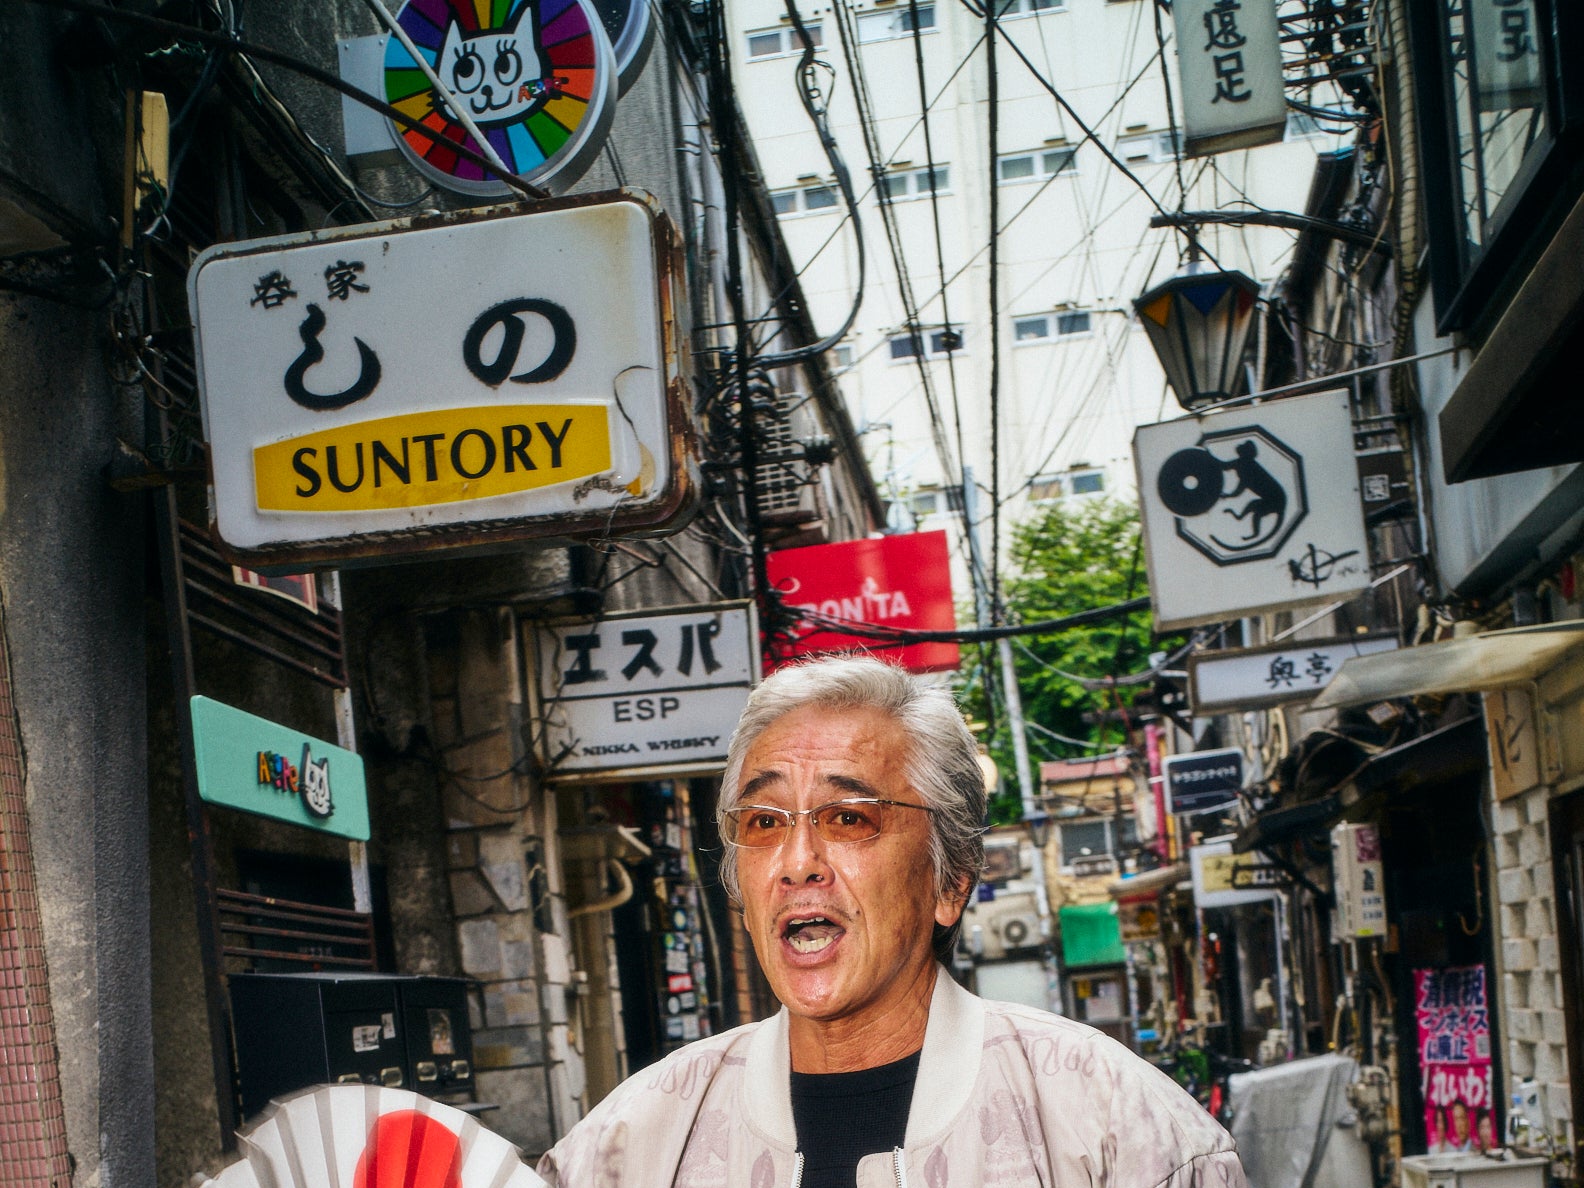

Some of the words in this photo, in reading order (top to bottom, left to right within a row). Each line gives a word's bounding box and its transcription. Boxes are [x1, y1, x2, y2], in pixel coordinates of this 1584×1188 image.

[1203, 0, 1252, 104] 遠足
[292, 418, 573, 498] SUNTORY
[564, 619, 723, 685] エスパ
[612, 696, 680, 723] ESP
[582, 742, 640, 757] NIKKA
[646, 735, 721, 752] WHISKY
